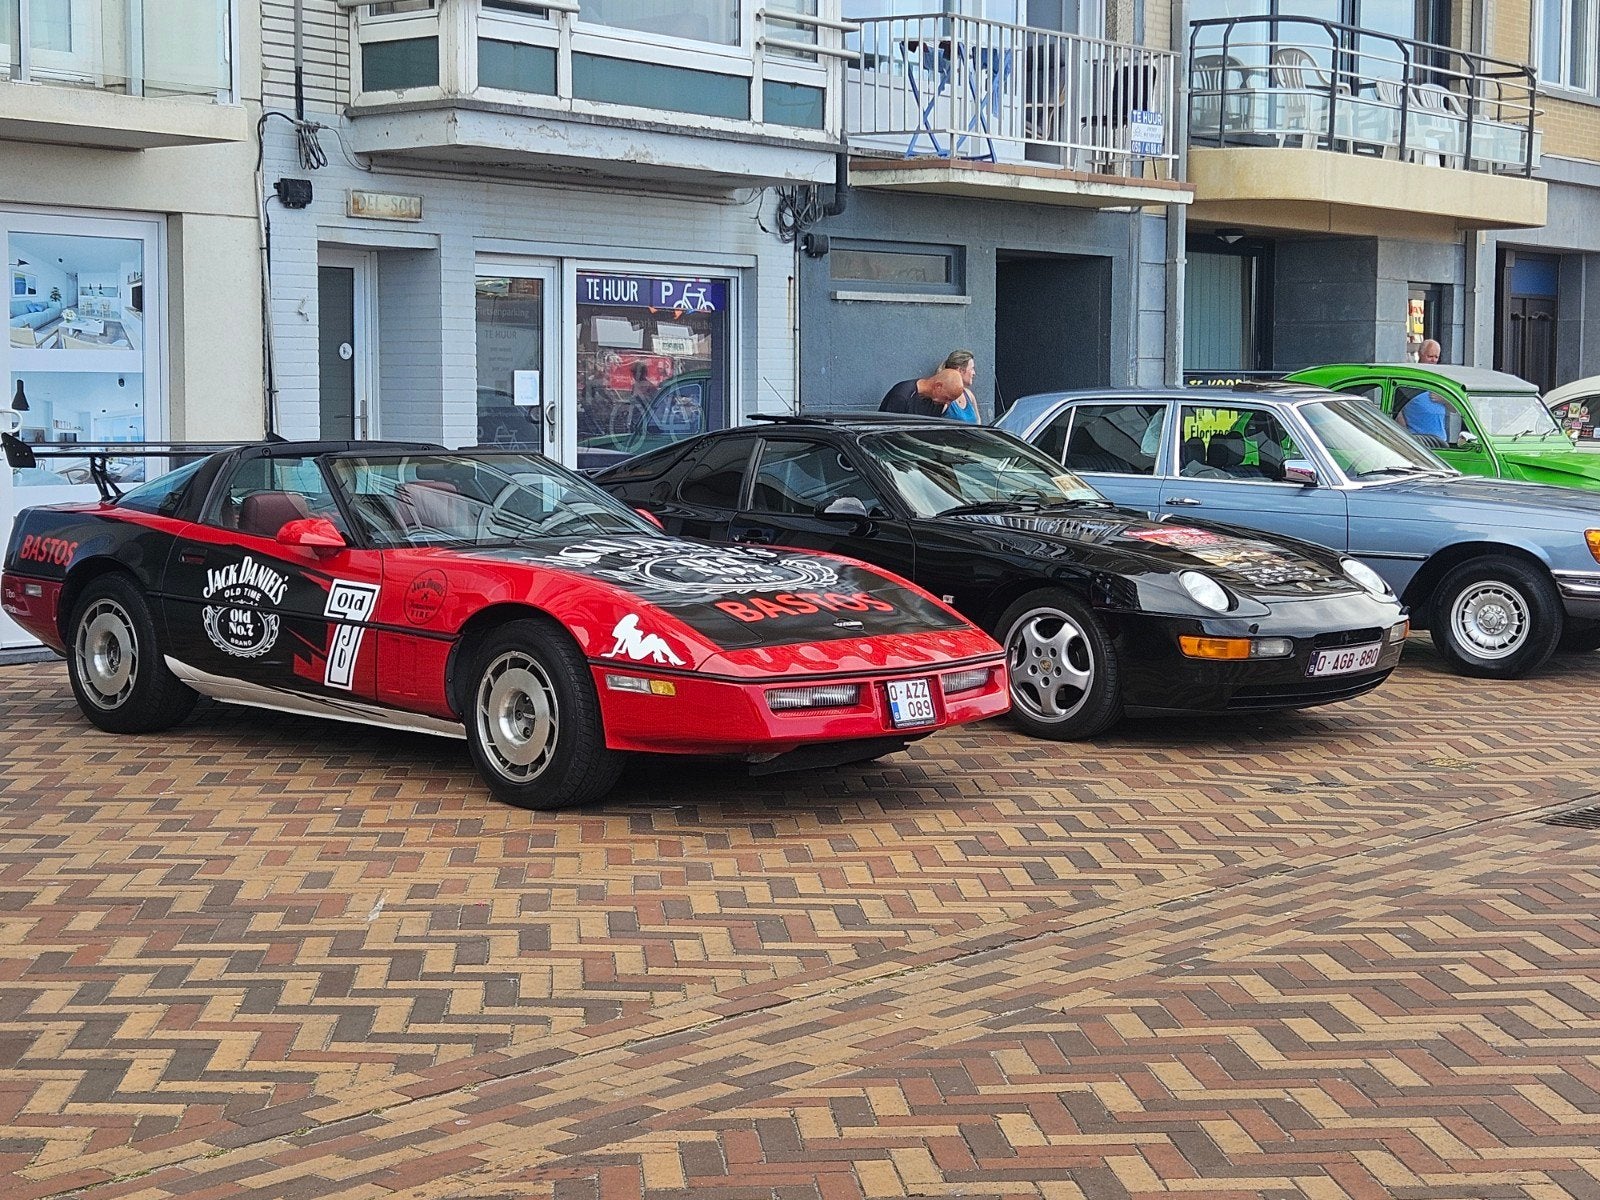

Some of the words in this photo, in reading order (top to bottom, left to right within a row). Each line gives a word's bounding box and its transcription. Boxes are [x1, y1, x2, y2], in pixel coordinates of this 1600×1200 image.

[1133, 110, 1142, 122] TE
[1143, 111, 1162, 125] HUUR
[586, 278, 600, 300] TE
[602, 279, 638, 302] HUUR
[661, 282, 674, 304] P
[20, 534, 79, 567] BASTOS
[203, 563, 239, 598] JACK
[238, 556, 289, 605] DANIEL'S
[721, 575, 784, 583] BRAND
[224, 587, 241, 598] OLD
[243, 587, 261, 601] TIME
[337, 592, 366, 611] Old
[230, 608, 251, 623] Old
[714, 592, 894, 623] BASTOS
[229, 622, 254, 637] No.7
[230, 637, 252, 647] BRAND
[908, 699, 931, 718] 089
